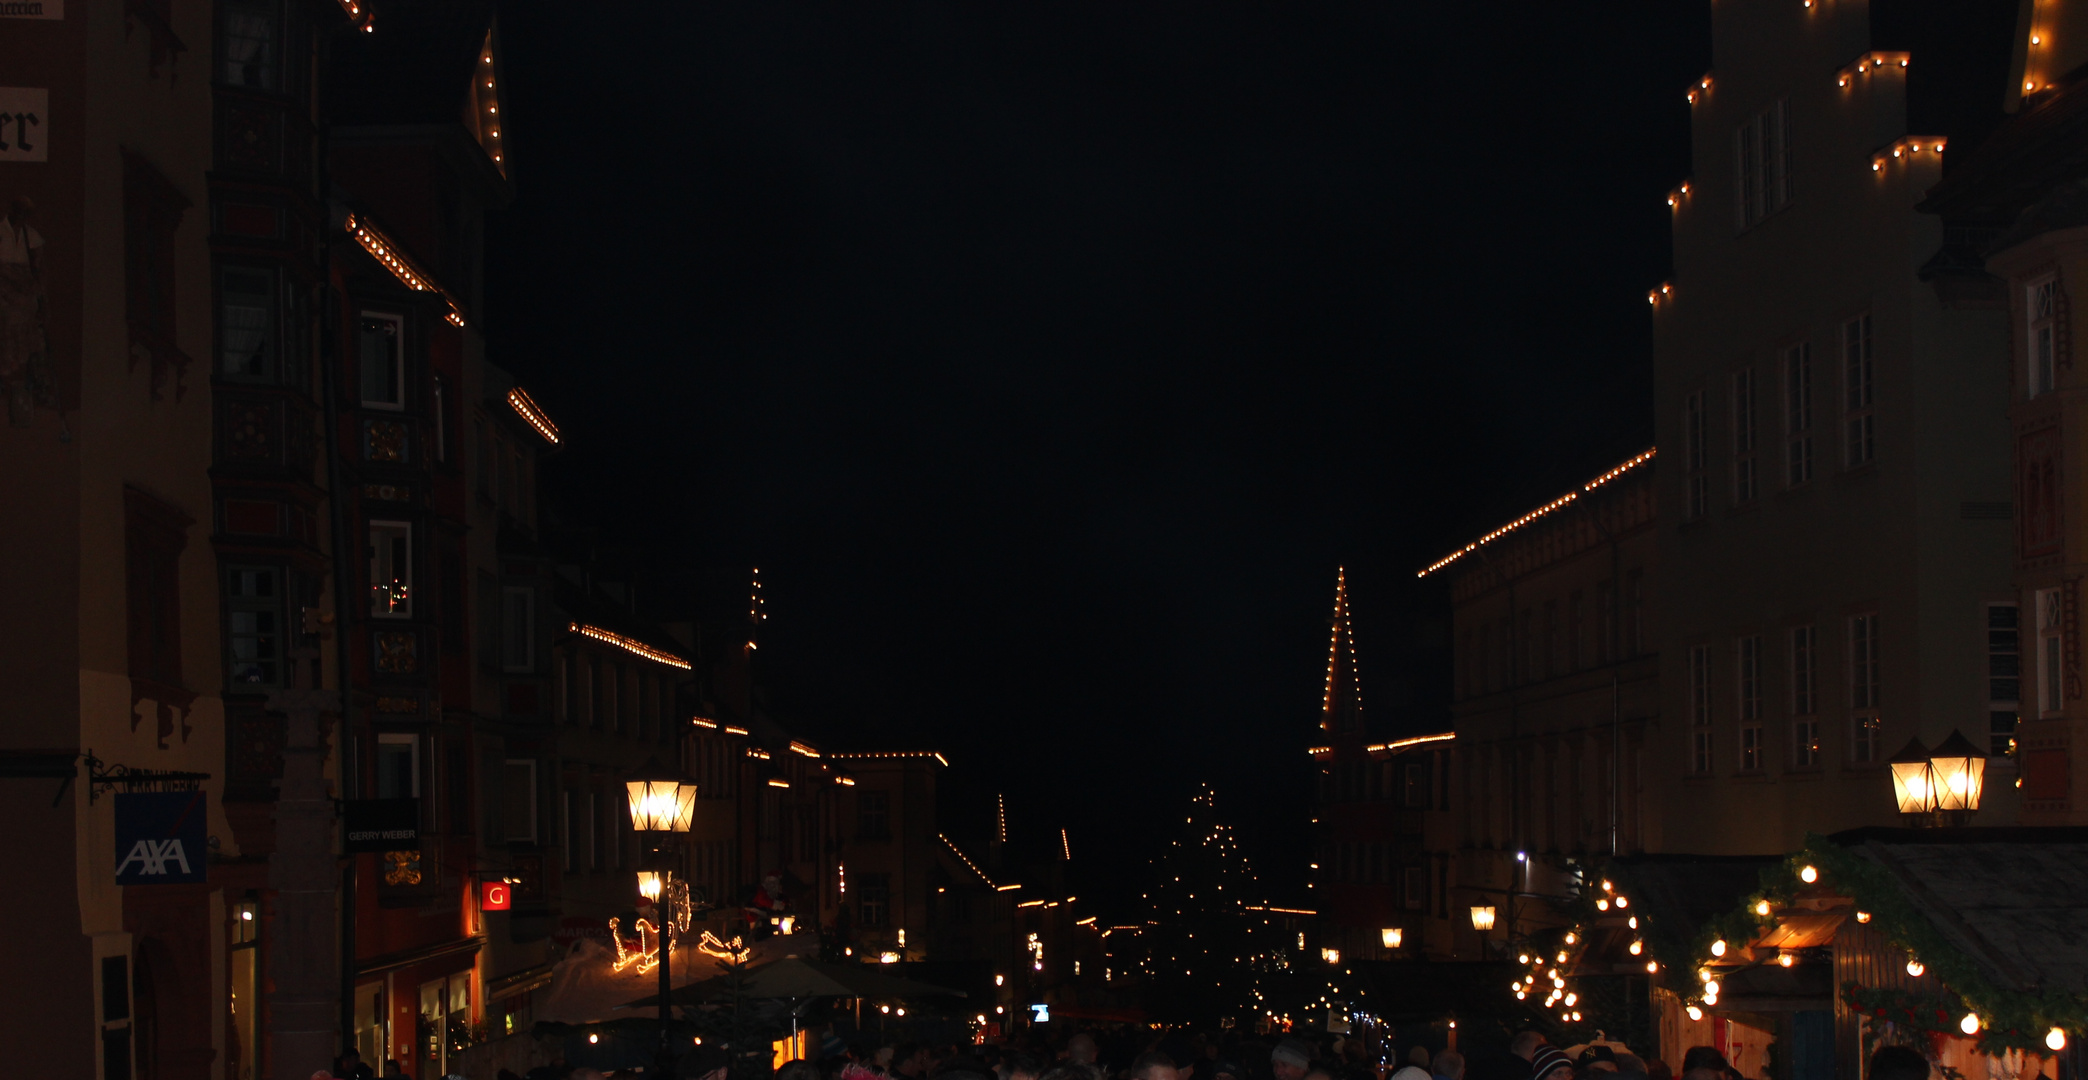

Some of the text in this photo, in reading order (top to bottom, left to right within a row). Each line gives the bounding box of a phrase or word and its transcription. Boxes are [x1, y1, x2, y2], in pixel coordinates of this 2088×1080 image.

[348, 829, 416, 841] GERRY WEBER
[116, 838, 192, 876] AXA
[489, 887, 503, 904] G
